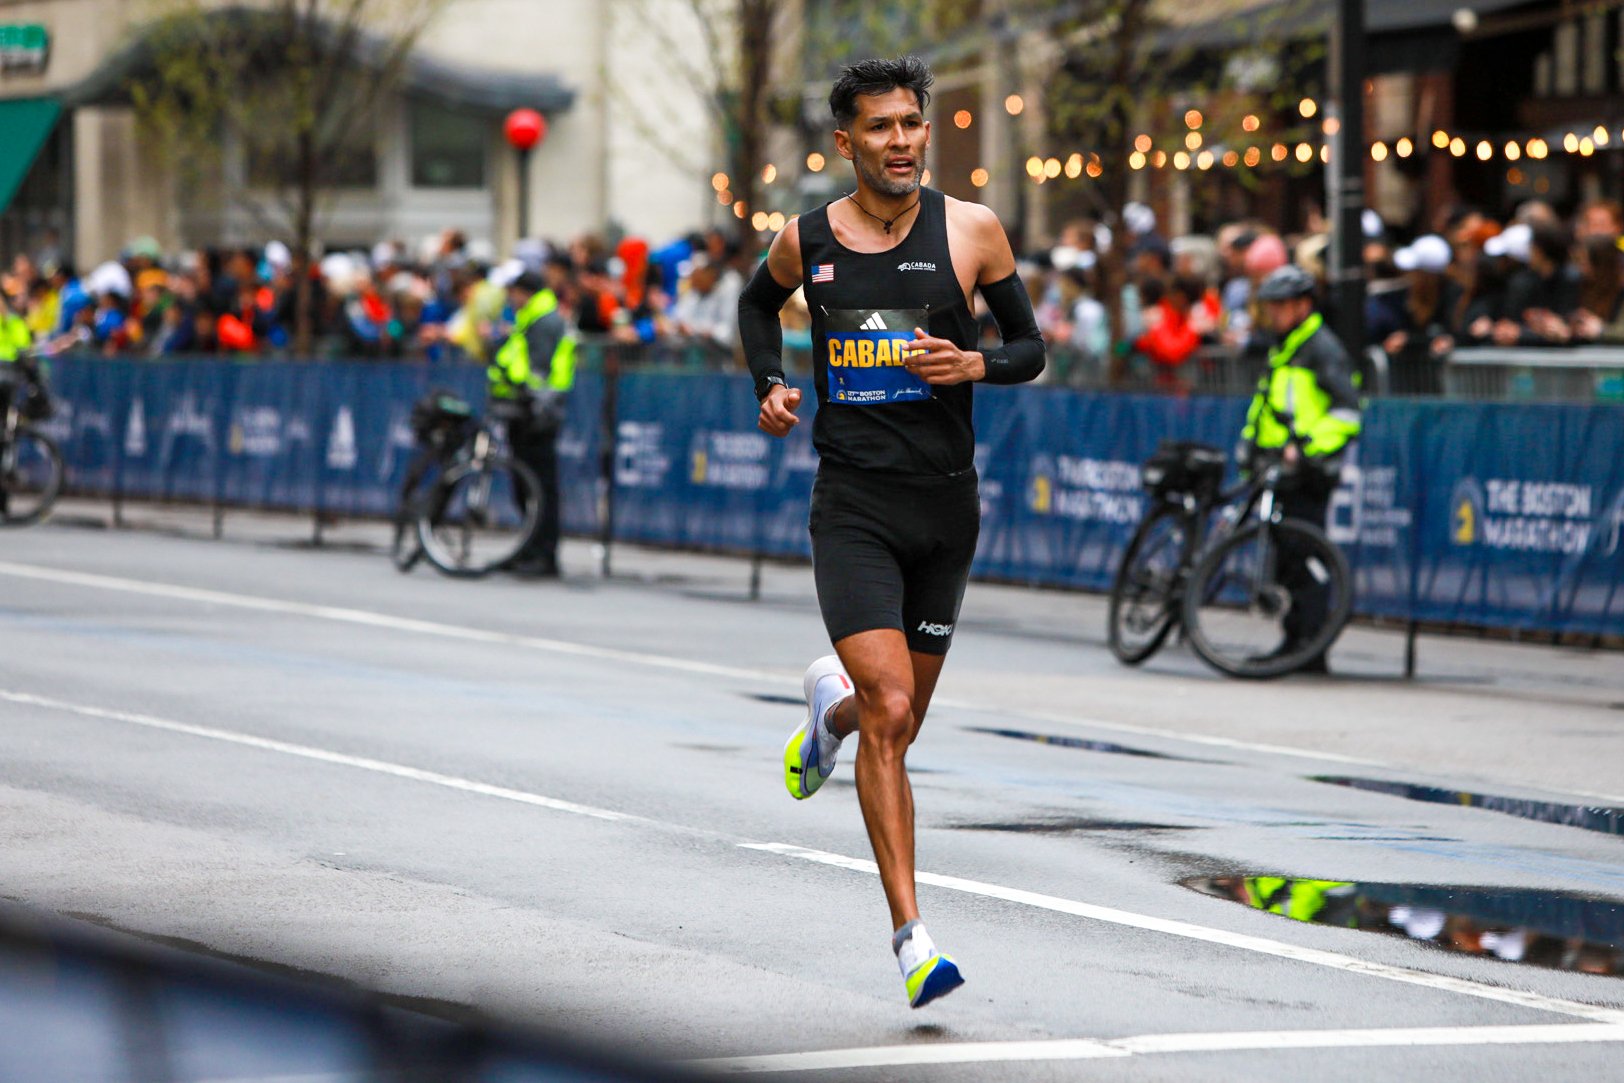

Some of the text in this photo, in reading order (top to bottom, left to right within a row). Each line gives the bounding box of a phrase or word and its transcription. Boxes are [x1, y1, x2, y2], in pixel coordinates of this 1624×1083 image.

[910, 261, 936, 269] CABADA
[1486, 479, 1592, 518] THE BOSTON
